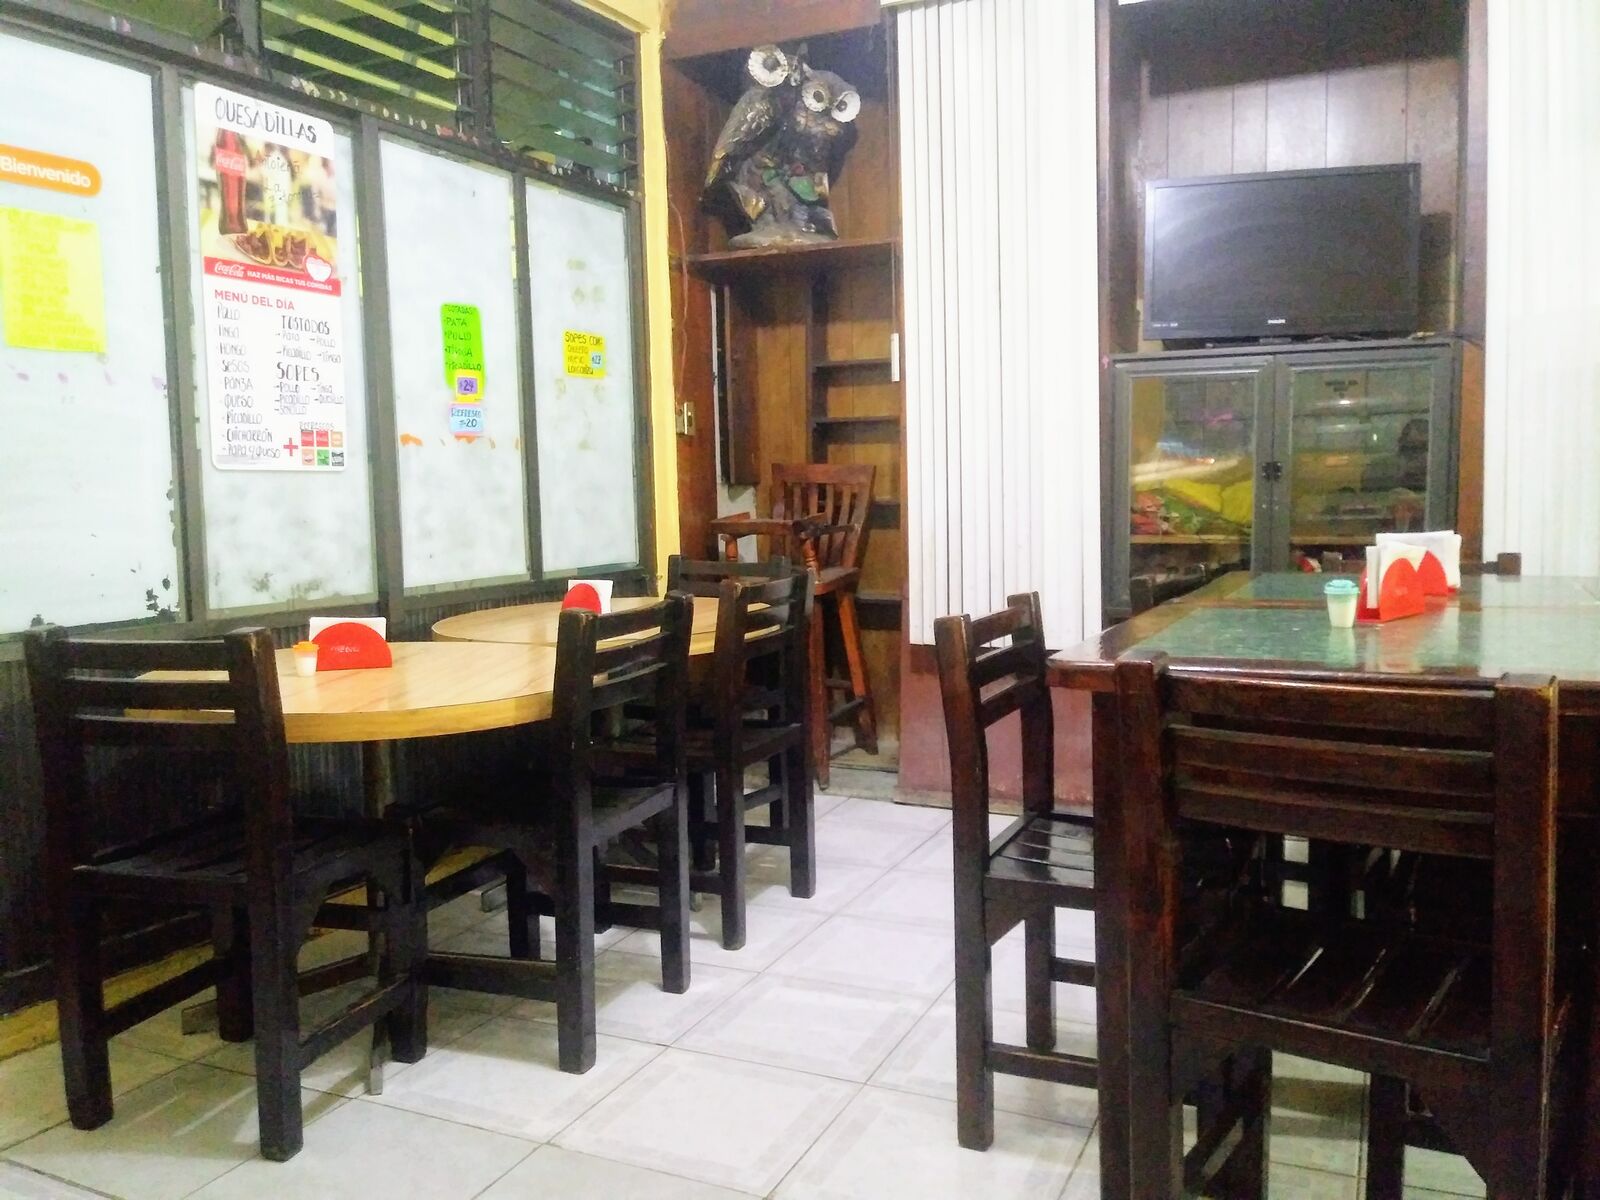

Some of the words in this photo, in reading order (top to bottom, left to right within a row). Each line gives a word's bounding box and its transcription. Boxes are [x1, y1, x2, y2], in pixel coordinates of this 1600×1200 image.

[0, 155, 91, 188] Bienvenido
[247, 270, 261, 279] HAZ
[252, 295, 273, 307] DEL
